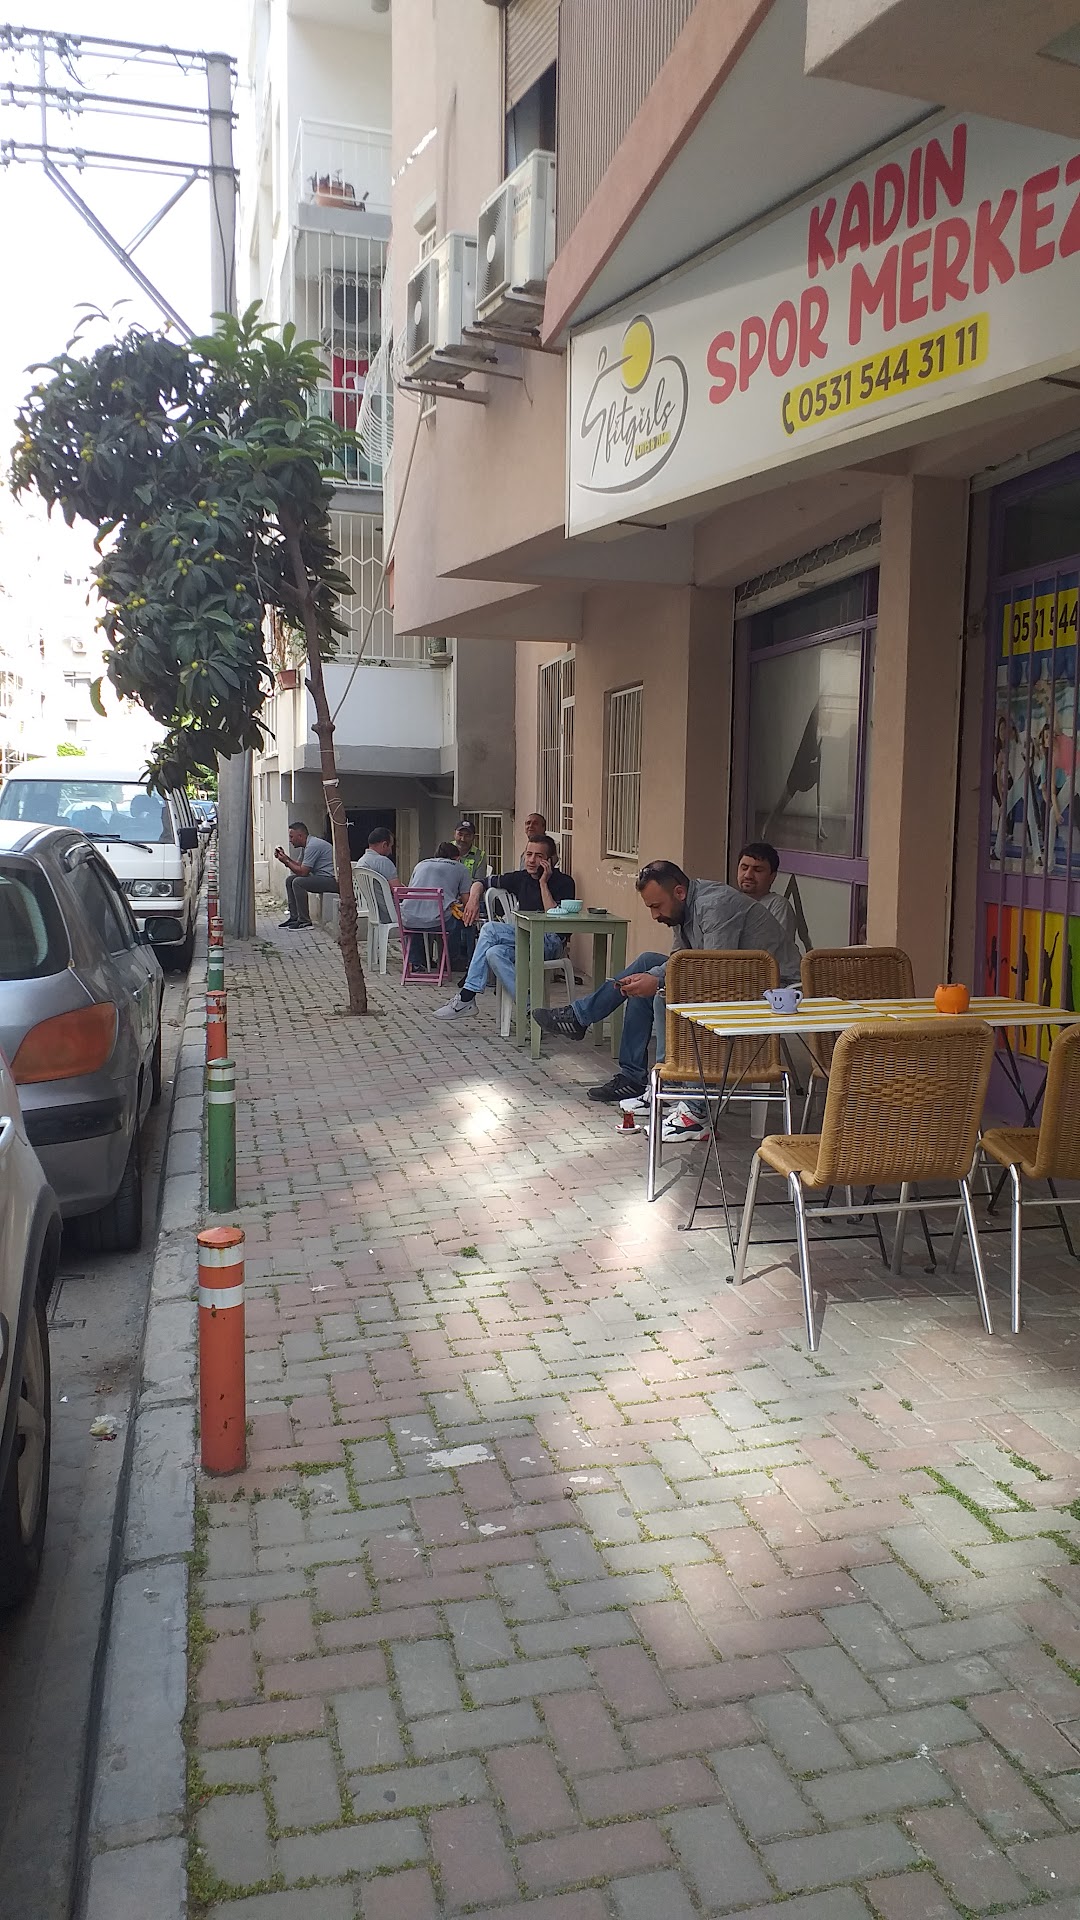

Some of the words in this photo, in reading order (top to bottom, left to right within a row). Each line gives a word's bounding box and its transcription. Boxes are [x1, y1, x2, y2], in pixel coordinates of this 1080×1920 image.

[807, 123, 967, 279] KADIN
[706, 286, 829, 405] SPOR
[798, 370, 853, 422] 0531
[859, 348, 910, 400] 544
[917, 333, 946, 379] 31
[955, 321, 979, 367] 11
